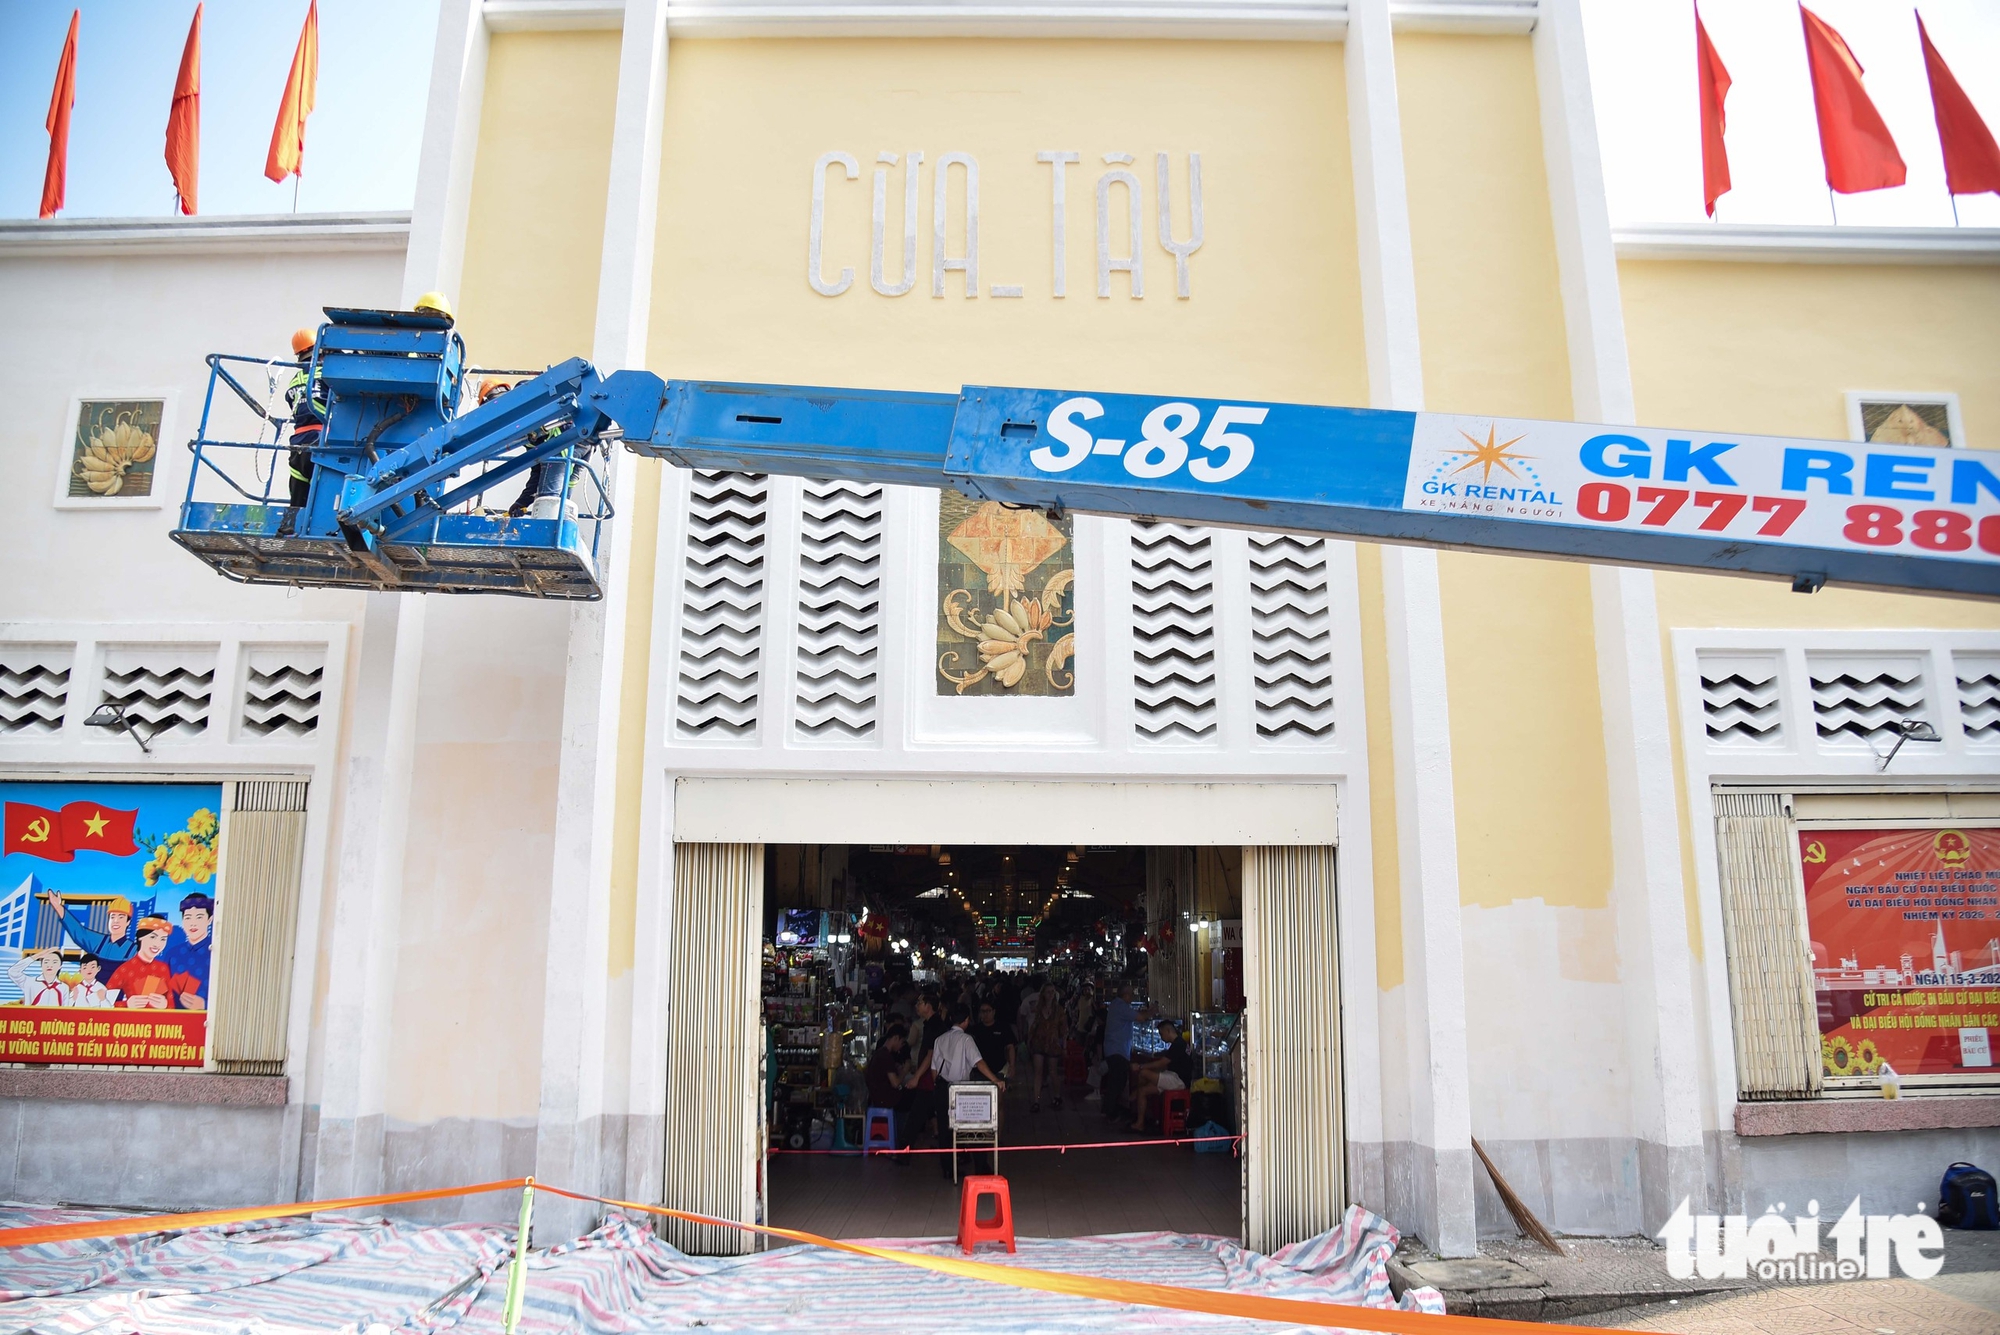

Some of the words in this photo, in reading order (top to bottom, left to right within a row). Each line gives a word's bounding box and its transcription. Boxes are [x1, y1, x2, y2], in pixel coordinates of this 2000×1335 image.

[1030, 397, 1270, 483] S-85
[1579, 434, 1741, 487] GK
[1422, 481, 1458, 497] GK
[1465, 484, 1563, 505] RENTAL
[1420, 499, 1436, 507] XE
[1449, 500, 1494, 512] NÂNG
[1507, 506, 1563, 518] NGƯỜI
[1576, 482, 1808, 538] 0777
[1845, 883, 1875, 895] NGÀY
[1847, 897, 1862, 908] VÀ
[1864, 899, 1883, 910] ĐẠI
[1903, 910, 1939, 921] NHIỆM
[1914, 972, 1946, 986] NGÀY
[1863, 989, 1876, 1007] CỬ
[1876, 993, 1891, 1006] TRI
[1890, 989, 1904, 1007] CẢ
[1903, 990, 1926, 1006] NƯỚC
[9, 1020, 37, 1038] NGỌ,
[40, 1018, 76, 1035] MỪNG
[78, 1017, 111, 1037] ĐẢNG
[113, 1022, 153, 1039] QUANG
[154, 1024, 186, 1041] VINH,
[1850, 1013, 1862, 1029] VÀ
[1862, 1016, 1878, 1032] ĐẠI
[1878, 1010, 1898, 1029] BIỂU
[1898, 1013, 1914, 1031] HỘI
[8, 1038, 40, 1055] VỮNG
[43, 1038, 74, 1056] VÀNG
[77, 1038, 103, 1057] TIẾN
[105, 1040, 129, 1058] VÀO
[130, 1039, 147, 1059] KỶ
[148, 1042, 197, 1061] NGUYÊN
